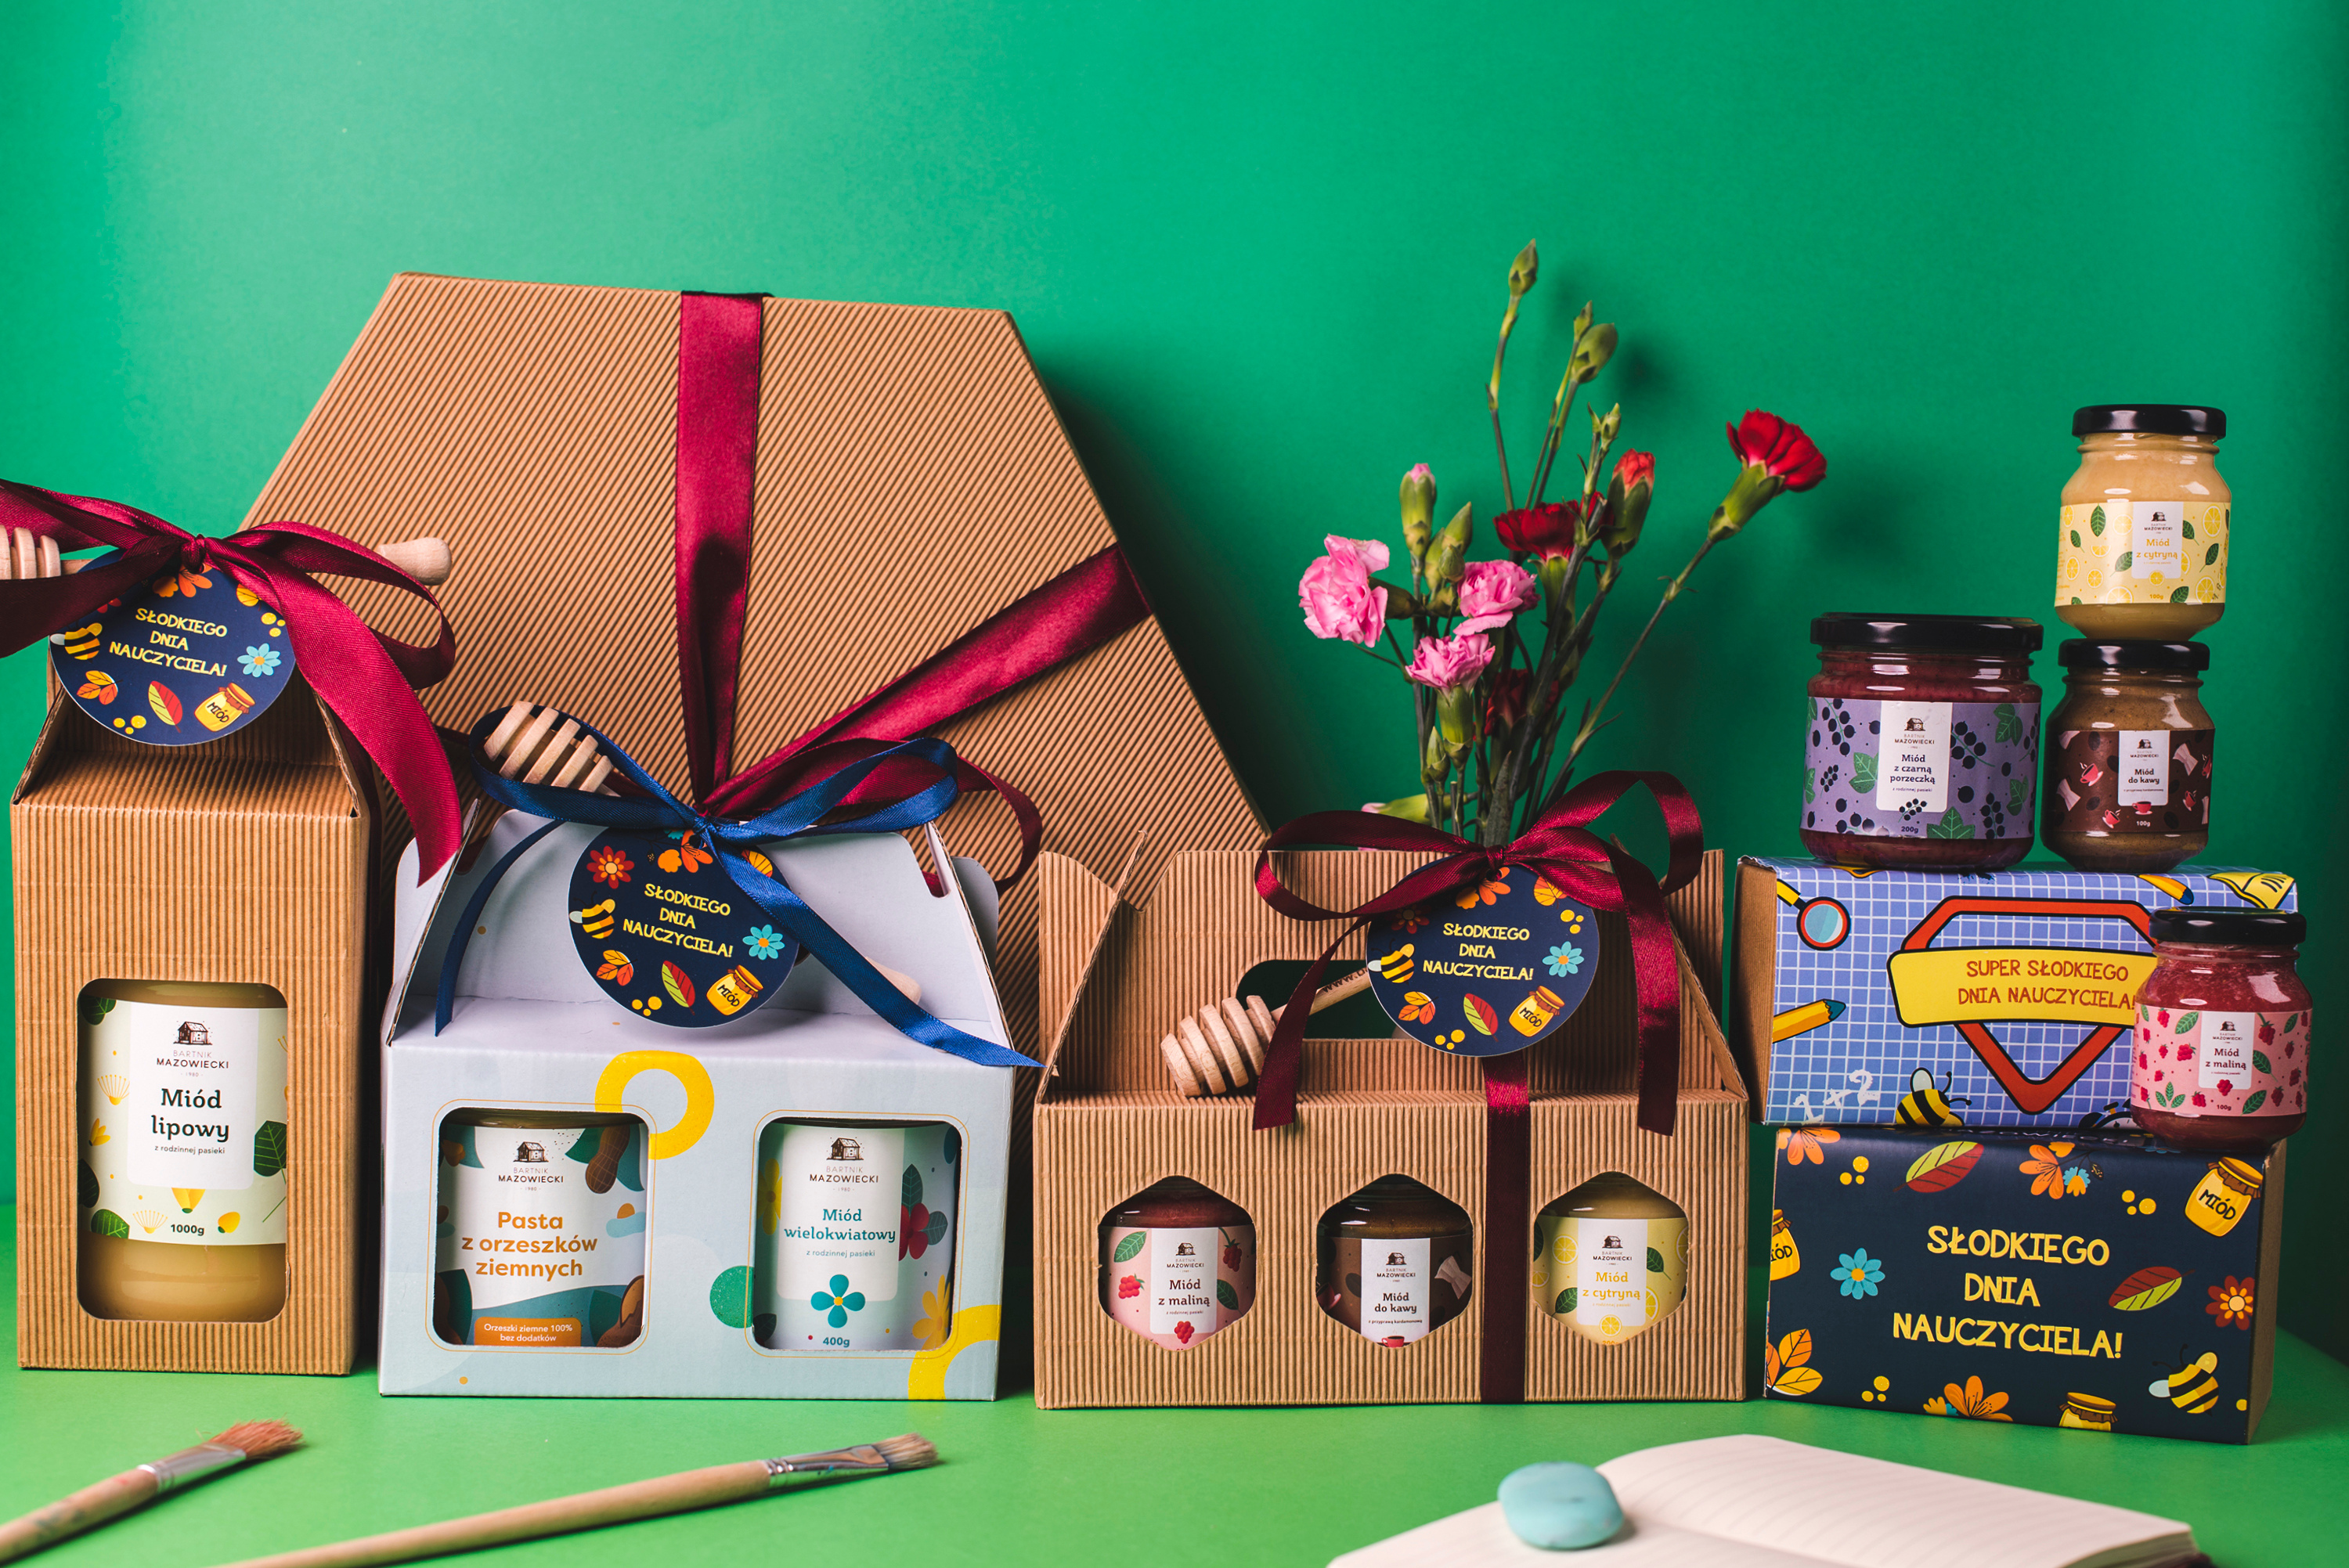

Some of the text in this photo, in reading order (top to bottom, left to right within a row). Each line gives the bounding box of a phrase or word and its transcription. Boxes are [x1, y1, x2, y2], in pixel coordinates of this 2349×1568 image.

[2145, 551, 2178, 560] cytryną
[135, 607, 227, 637] SŁODKIEGO
[150, 630, 189, 651] DNIA
[109, 641, 227, 676] NAUCZYCIELA!
[207, 701, 230, 723] MIÓD
[1901, 754, 1925, 762] Miód
[1901, 765, 1932, 774] czarną
[1889, 774, 1936, 784] porzeczką
[2140, 777, 2160, 785] kawy
[644, 883, 731, 916] SŁODKIEGO
[659, 907, 696, 929] DNIA
[622, 918, 734, 957] NAUCZYCIELA!
[1442, 922, 1530, 941] SŁODKIEGO
[1459, 943, 1496, 959] DNIA
[1423, 960, 1534, 981] NAUCZYCIELA!
[1966, 959, 2129, 982] SUPER SŁODKIEGO
[716, 984, 740, 1007] MIÓD
[1958, 987, 2136, 1010] DNIA NAUCZYCIELA!
[1519, 1007, 1543, 1028] MIÓD
[173, 1050, 212, 1058] BARTNIK
[2214, 1047, 2239, 1057] Miód
[156, 1058, 229, 1069] MAZOWIECKI
[2213, 1060, 2246, 1071] maliną
[161, 1088, 222, 1108] Miód
[151, 1115, 229, 1143] lipowy
[161, 1145, 196, 1155] rodzinnej
[198, 1147, 226, 1155] pasieki
[498, 1174, 564, 1183] MAZOWIECKI
[809, 1174, 879, 1183] MAZOWIECKI
[2199, 1188, 2236, 1220] MIÓD
[498, 1212, 563, 1229] Pasta
[822, 1209, 862, 1221] Miód
[170, 1224, 205, 1236] 1000g
[784, 1226, 896, 1243] wielokwiatowy
[461, 1235, 597, 1253] z orzeszków
[1926, 1224, 2110, 1267] SŁODKIEGO
[812, 1249, 847, 1258] rodzinnej
[1770, 1243, 1793, 1262] IÓD
[475, 1258, 583, 1281] ziemnych
[1596, 1271, 1629, 1282] Miód
[1169, 1278, 1201, 1289] Miód
[1964, 1272, 2040, 1307] DNIA
[1158, 1294, 1210, 1307] z maliną
[1383, 1292, 1409, 1301] Miód
[1593, 1289, 1641, 1301] cytryną
[1374, 1303, 1417, 1314] do kawy
[484, 1323, 518, 1332] Orzeszki
[1893, 1311, 2123, 1360] NAUCZYCIELA!
[500, 1333, 557, 1343] bez dodatków
[822, 1336, 850, 1347] 400g
